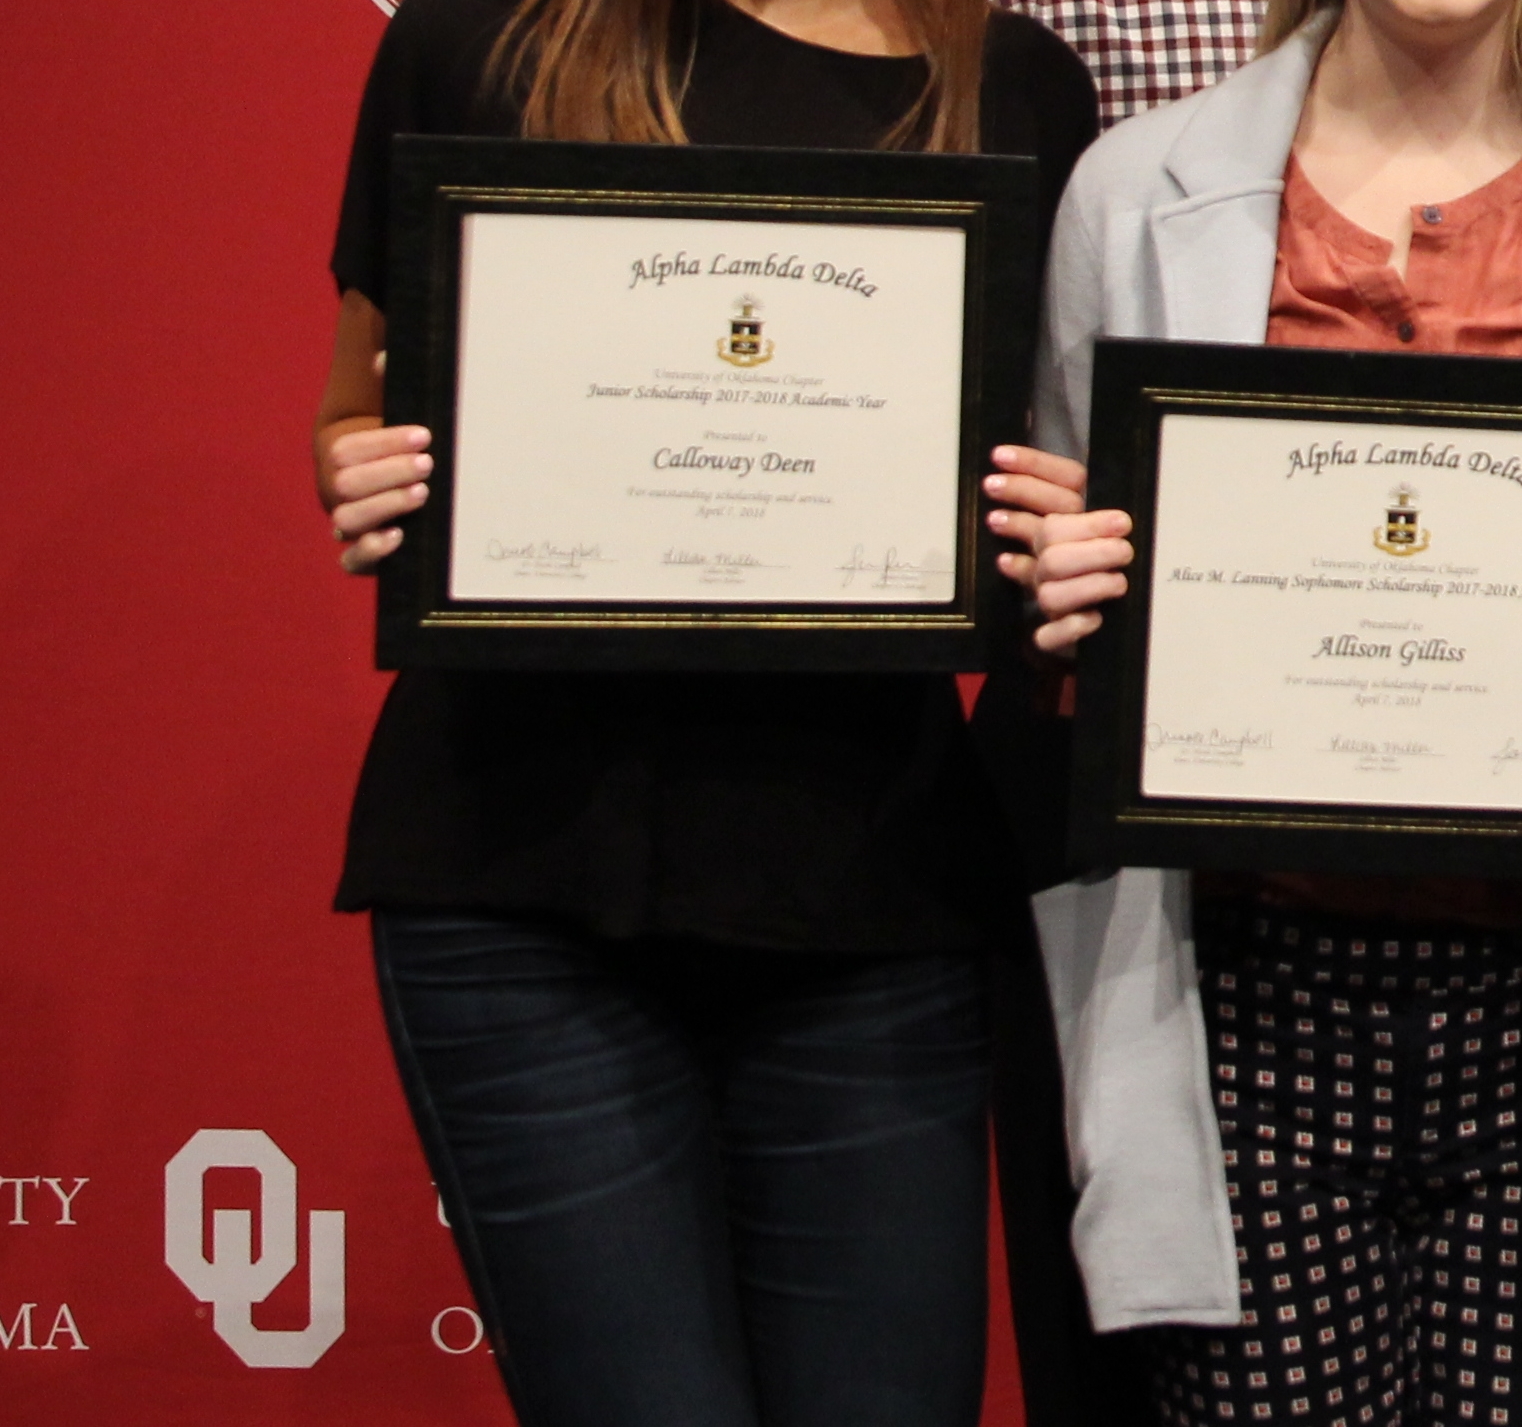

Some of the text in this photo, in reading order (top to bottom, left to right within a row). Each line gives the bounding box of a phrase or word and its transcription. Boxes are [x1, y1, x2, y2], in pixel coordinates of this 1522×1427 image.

[629, 252, 878, 298] Alpha Lambda Delta
[587, 384, 887, 409] Junior Scholarship 2017-2018 Academic Year
[653, 446, 816, 478] Calloway Deen
[1287, 441, 1358, 479] Alpha
[1365, 443, 1460, 469] Lambda
[1168, 567, 1203, 582] Alice
[1231, 571, 1289, 590] Lanning
[1292, 573, 1363, 591] Sophomore
[1367, 577, 1443, 598] Scholarship
[1448, 581, 1518, 596] 2017-2018
[1312, 634, 1466, 666] Allison Gilliss
[165, 1128, 345, 1368] OU
